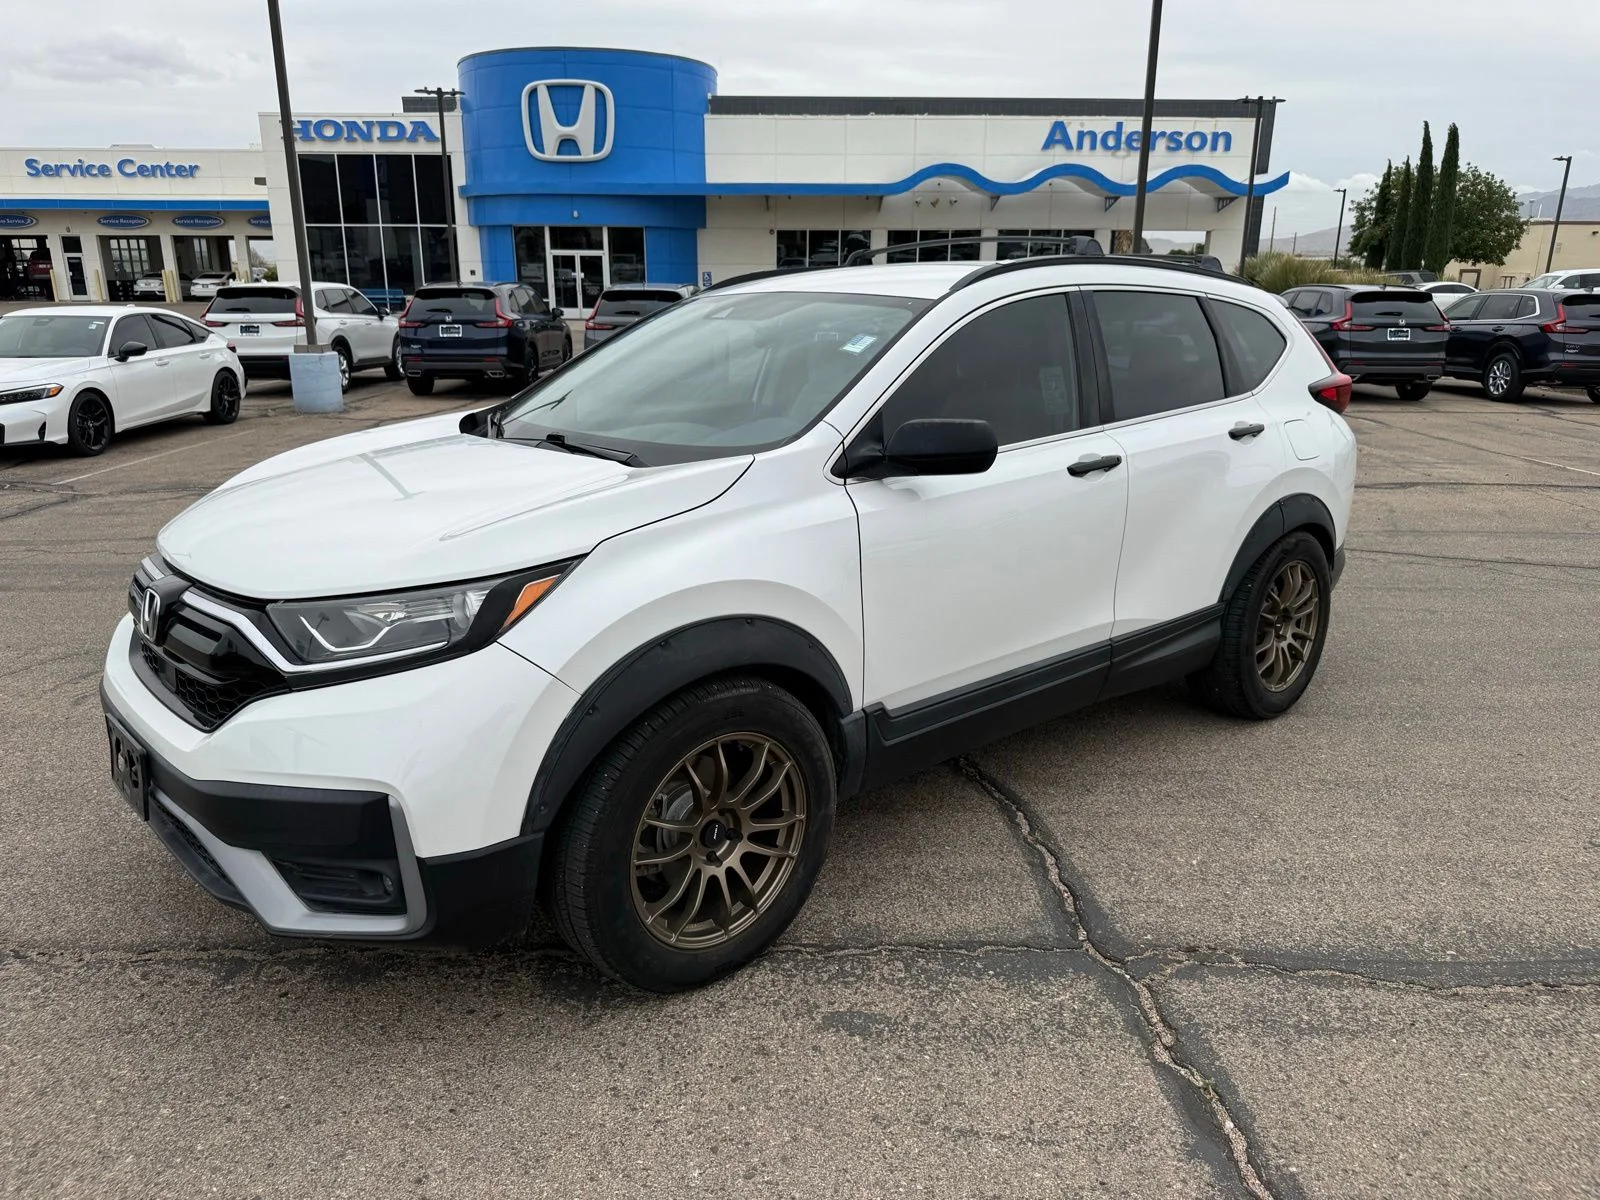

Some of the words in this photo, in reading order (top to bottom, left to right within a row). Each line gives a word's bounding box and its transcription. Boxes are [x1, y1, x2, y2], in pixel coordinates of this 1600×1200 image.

[1041, 120, 1233, 152] Anderson
[24, 158, 112, 177] Service
[117, 158, 200, 178] Center
